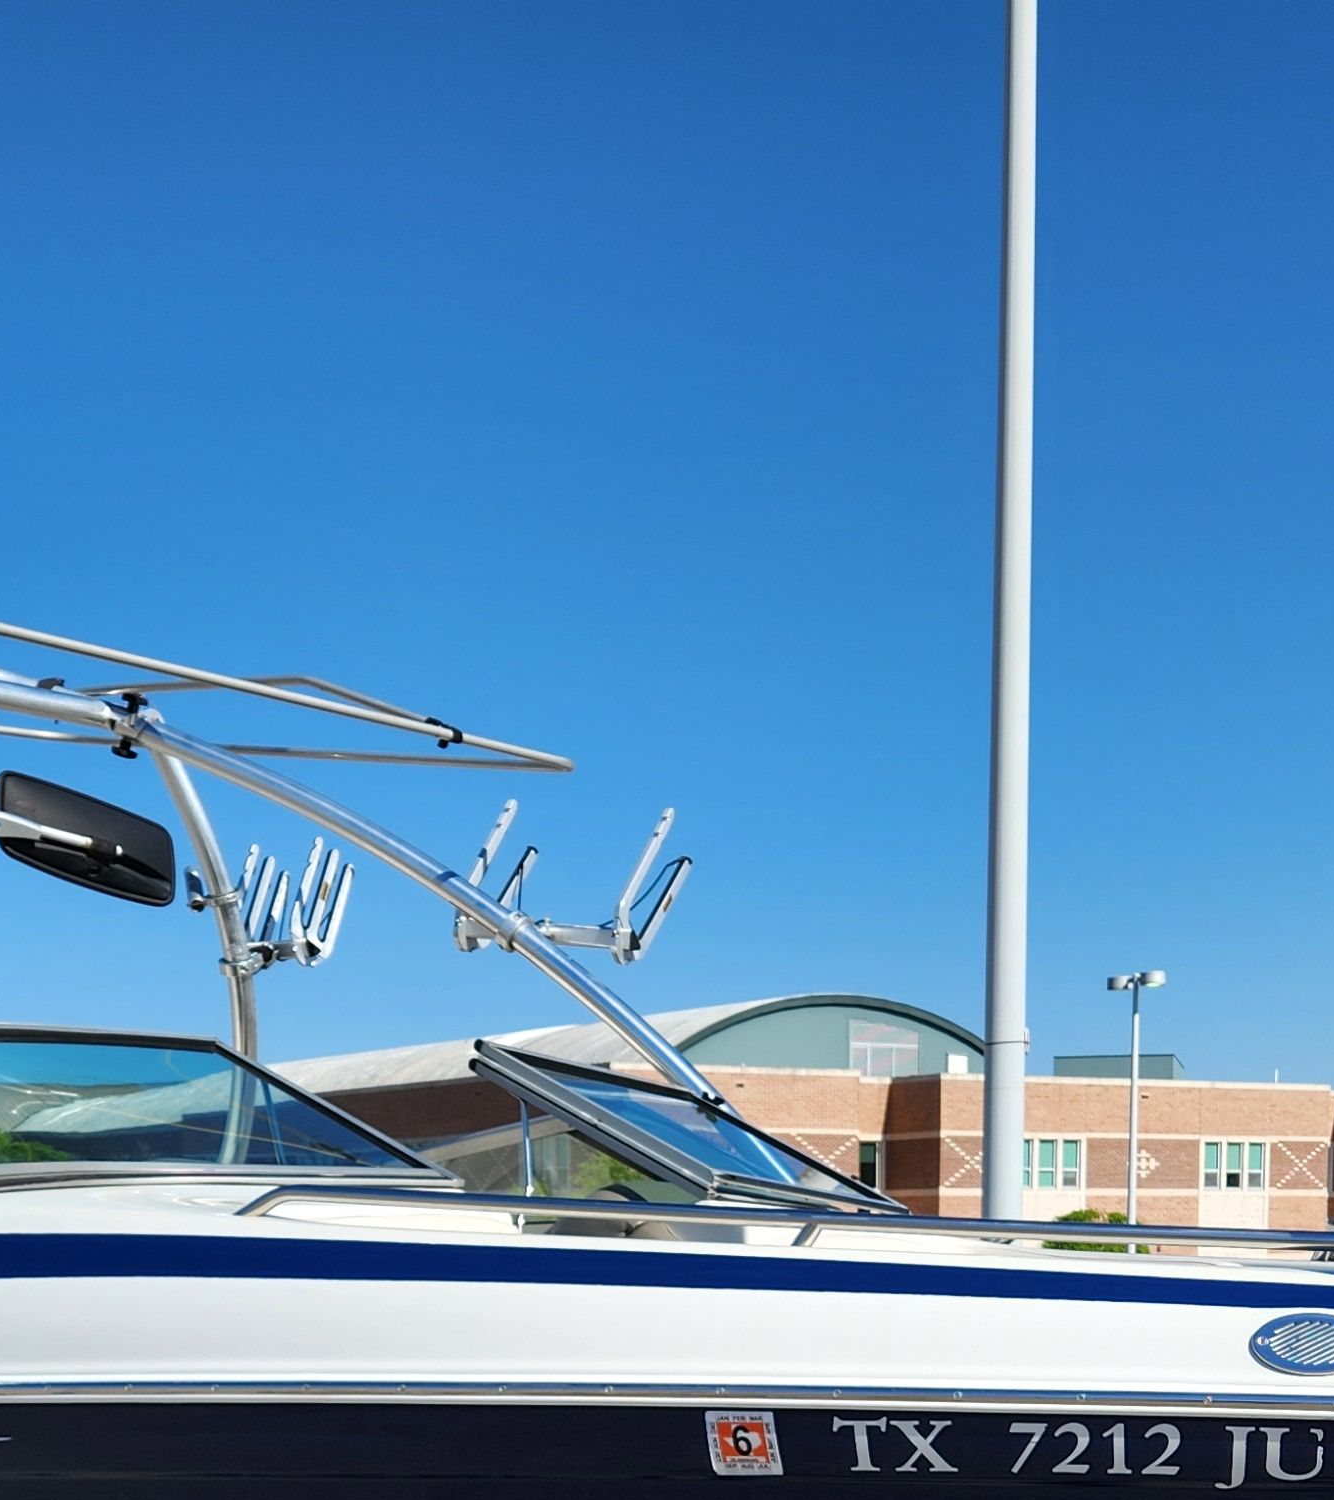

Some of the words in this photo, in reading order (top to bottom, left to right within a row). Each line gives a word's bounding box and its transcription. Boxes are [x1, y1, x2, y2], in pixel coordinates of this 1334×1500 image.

[732, 1425, 752, 1456] 6
[832, 1416, 959, 1473] TX
[1008, 1422, 1181, 1475] 7212
[1214, 1426, 1324, 1489] JU
